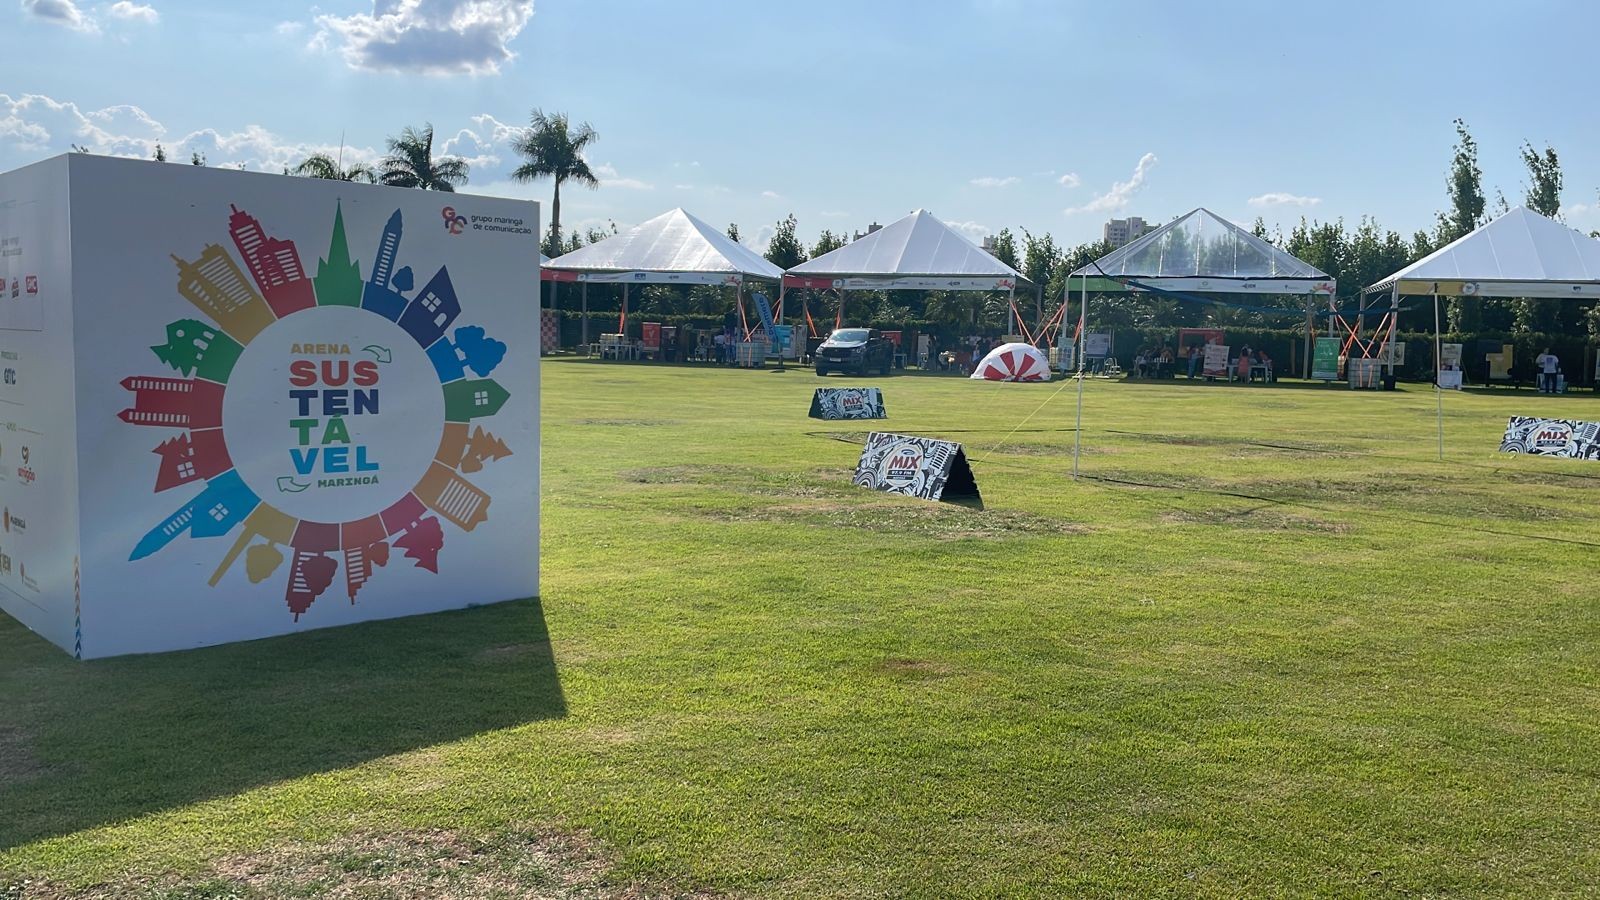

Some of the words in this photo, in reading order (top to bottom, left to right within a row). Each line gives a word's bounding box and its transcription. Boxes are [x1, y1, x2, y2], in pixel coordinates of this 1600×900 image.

[471, 215, 493, 223] grupo
[290, 343, 351, 355] ARENA
[289, 360, 379, 387] SUS
[289, 388, 379, 416] TEN
[843, 397, 862, 406] MIX
[289, 412, 351, 445] TÁ
[1536, 431, 1569, 440] MIX
[289, 446, 380, 475] VEL
[888, 455, 921, 469] MIX
[317, 474, 380, 488] MARINGÁ
